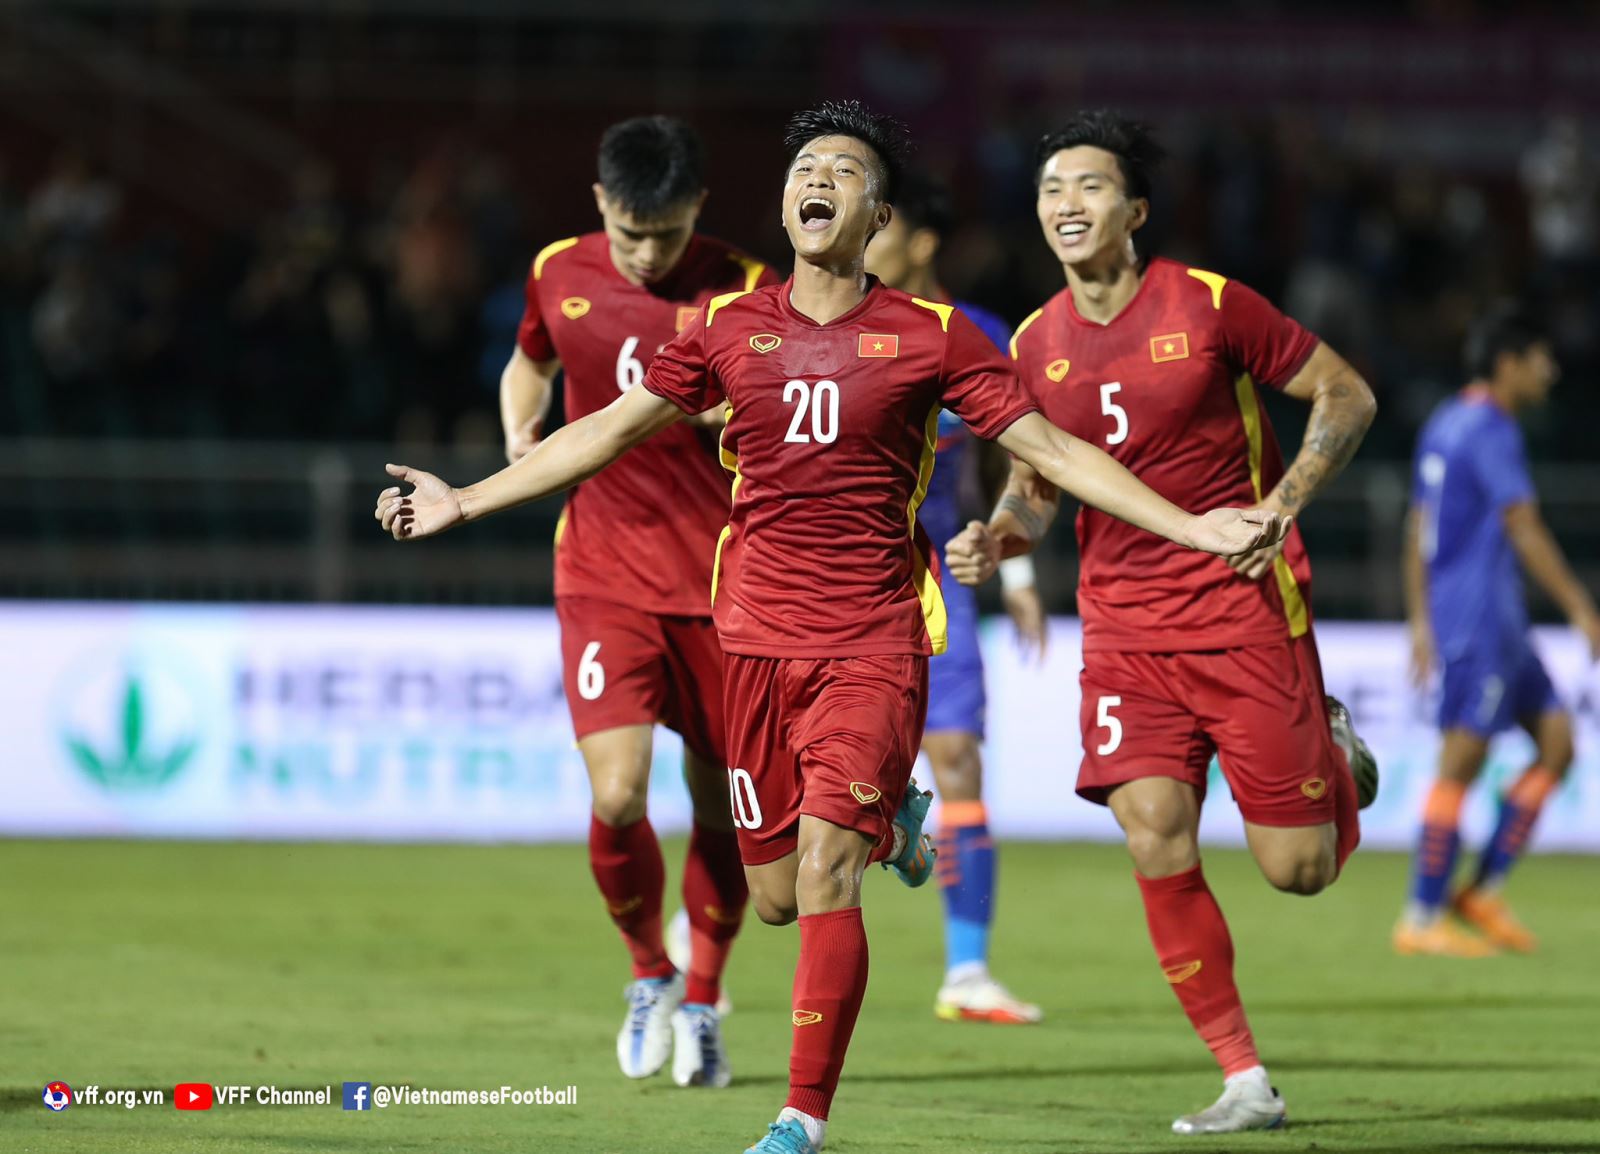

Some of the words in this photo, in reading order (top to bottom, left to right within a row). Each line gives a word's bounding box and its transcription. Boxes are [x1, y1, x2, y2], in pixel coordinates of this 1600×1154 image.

[615, 335, 645, 394] 6
[782, 379, 840, 444] 20
[1099, 381, 1129, 445] 5
[577, 641, 605, 700] 6
[1096, 695, 1124, 756] 5
